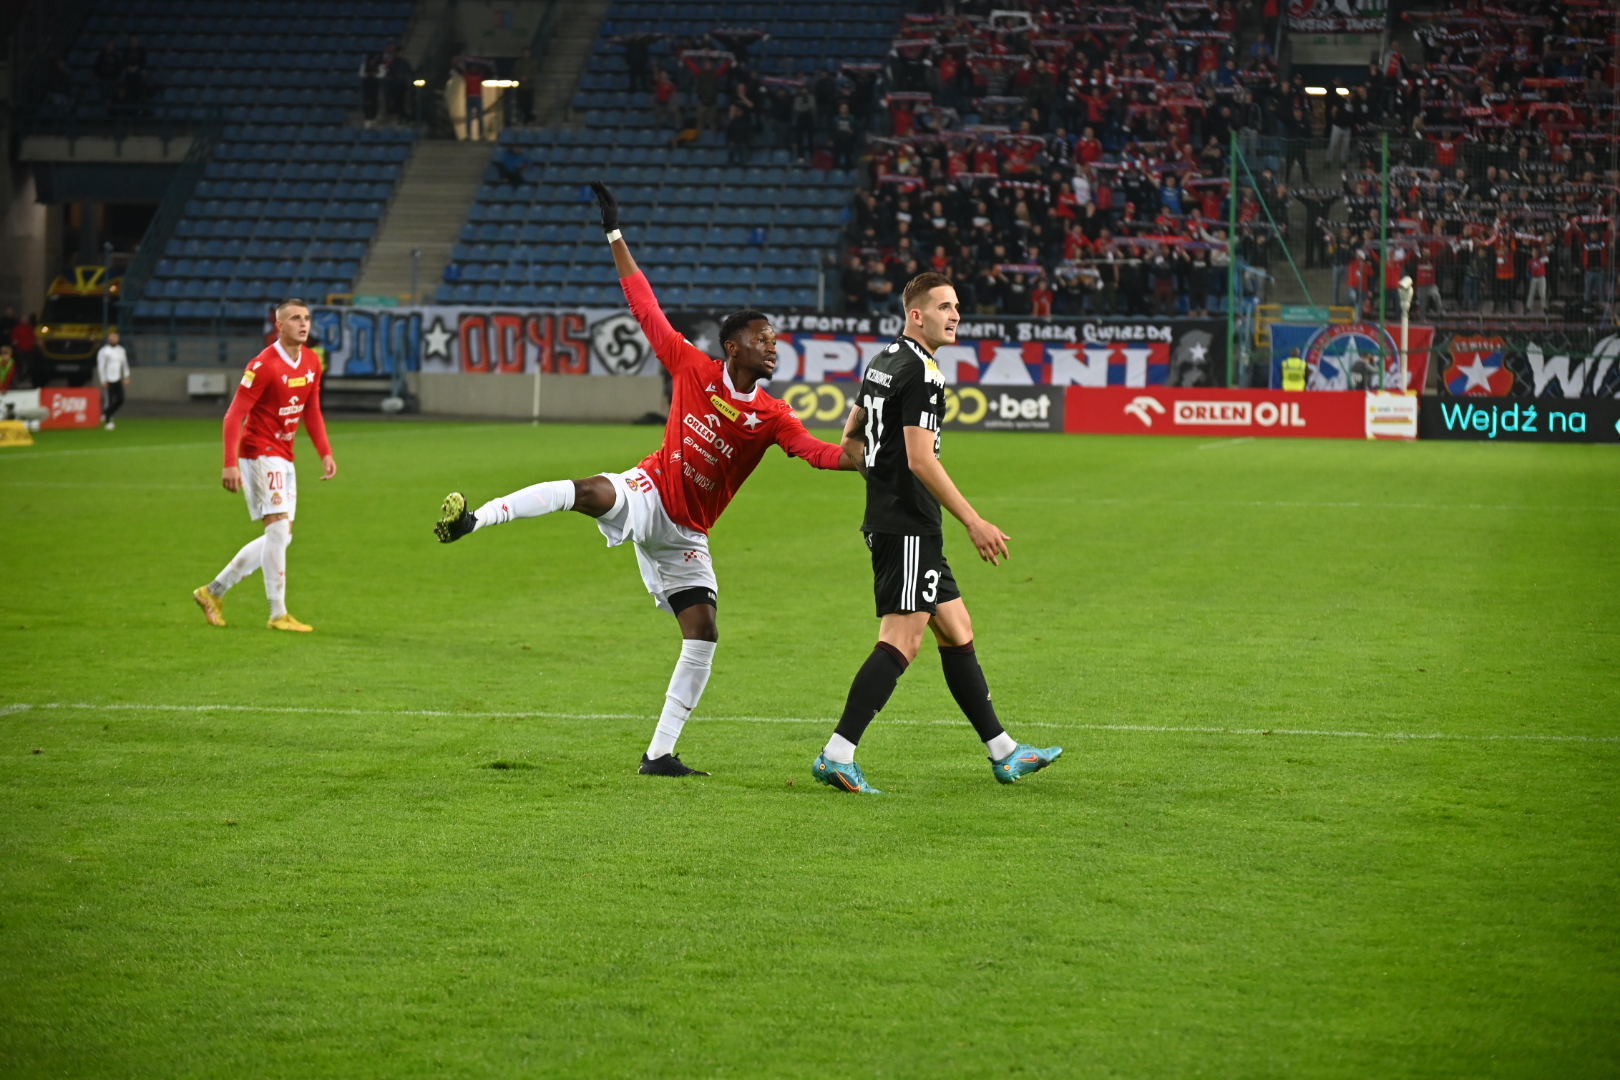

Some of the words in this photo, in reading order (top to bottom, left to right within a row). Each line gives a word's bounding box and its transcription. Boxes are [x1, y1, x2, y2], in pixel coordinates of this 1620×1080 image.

[711, 398, 736, 418] FORTUNA
[1180, 405, 1246, 421] ORLEN
[1254, 401, 1306, 427] OIL
[1441, 402, 1538, 438] Wejdź
[1549, 411, 1586, 433] na
[686, 416, 714, 441] ORLEN
[714, 438, 734, 459] OIL
[863, 394, 885, 468] 37
[267, 471, 283, 491] 20
[922, 569, 941, 606] 3
